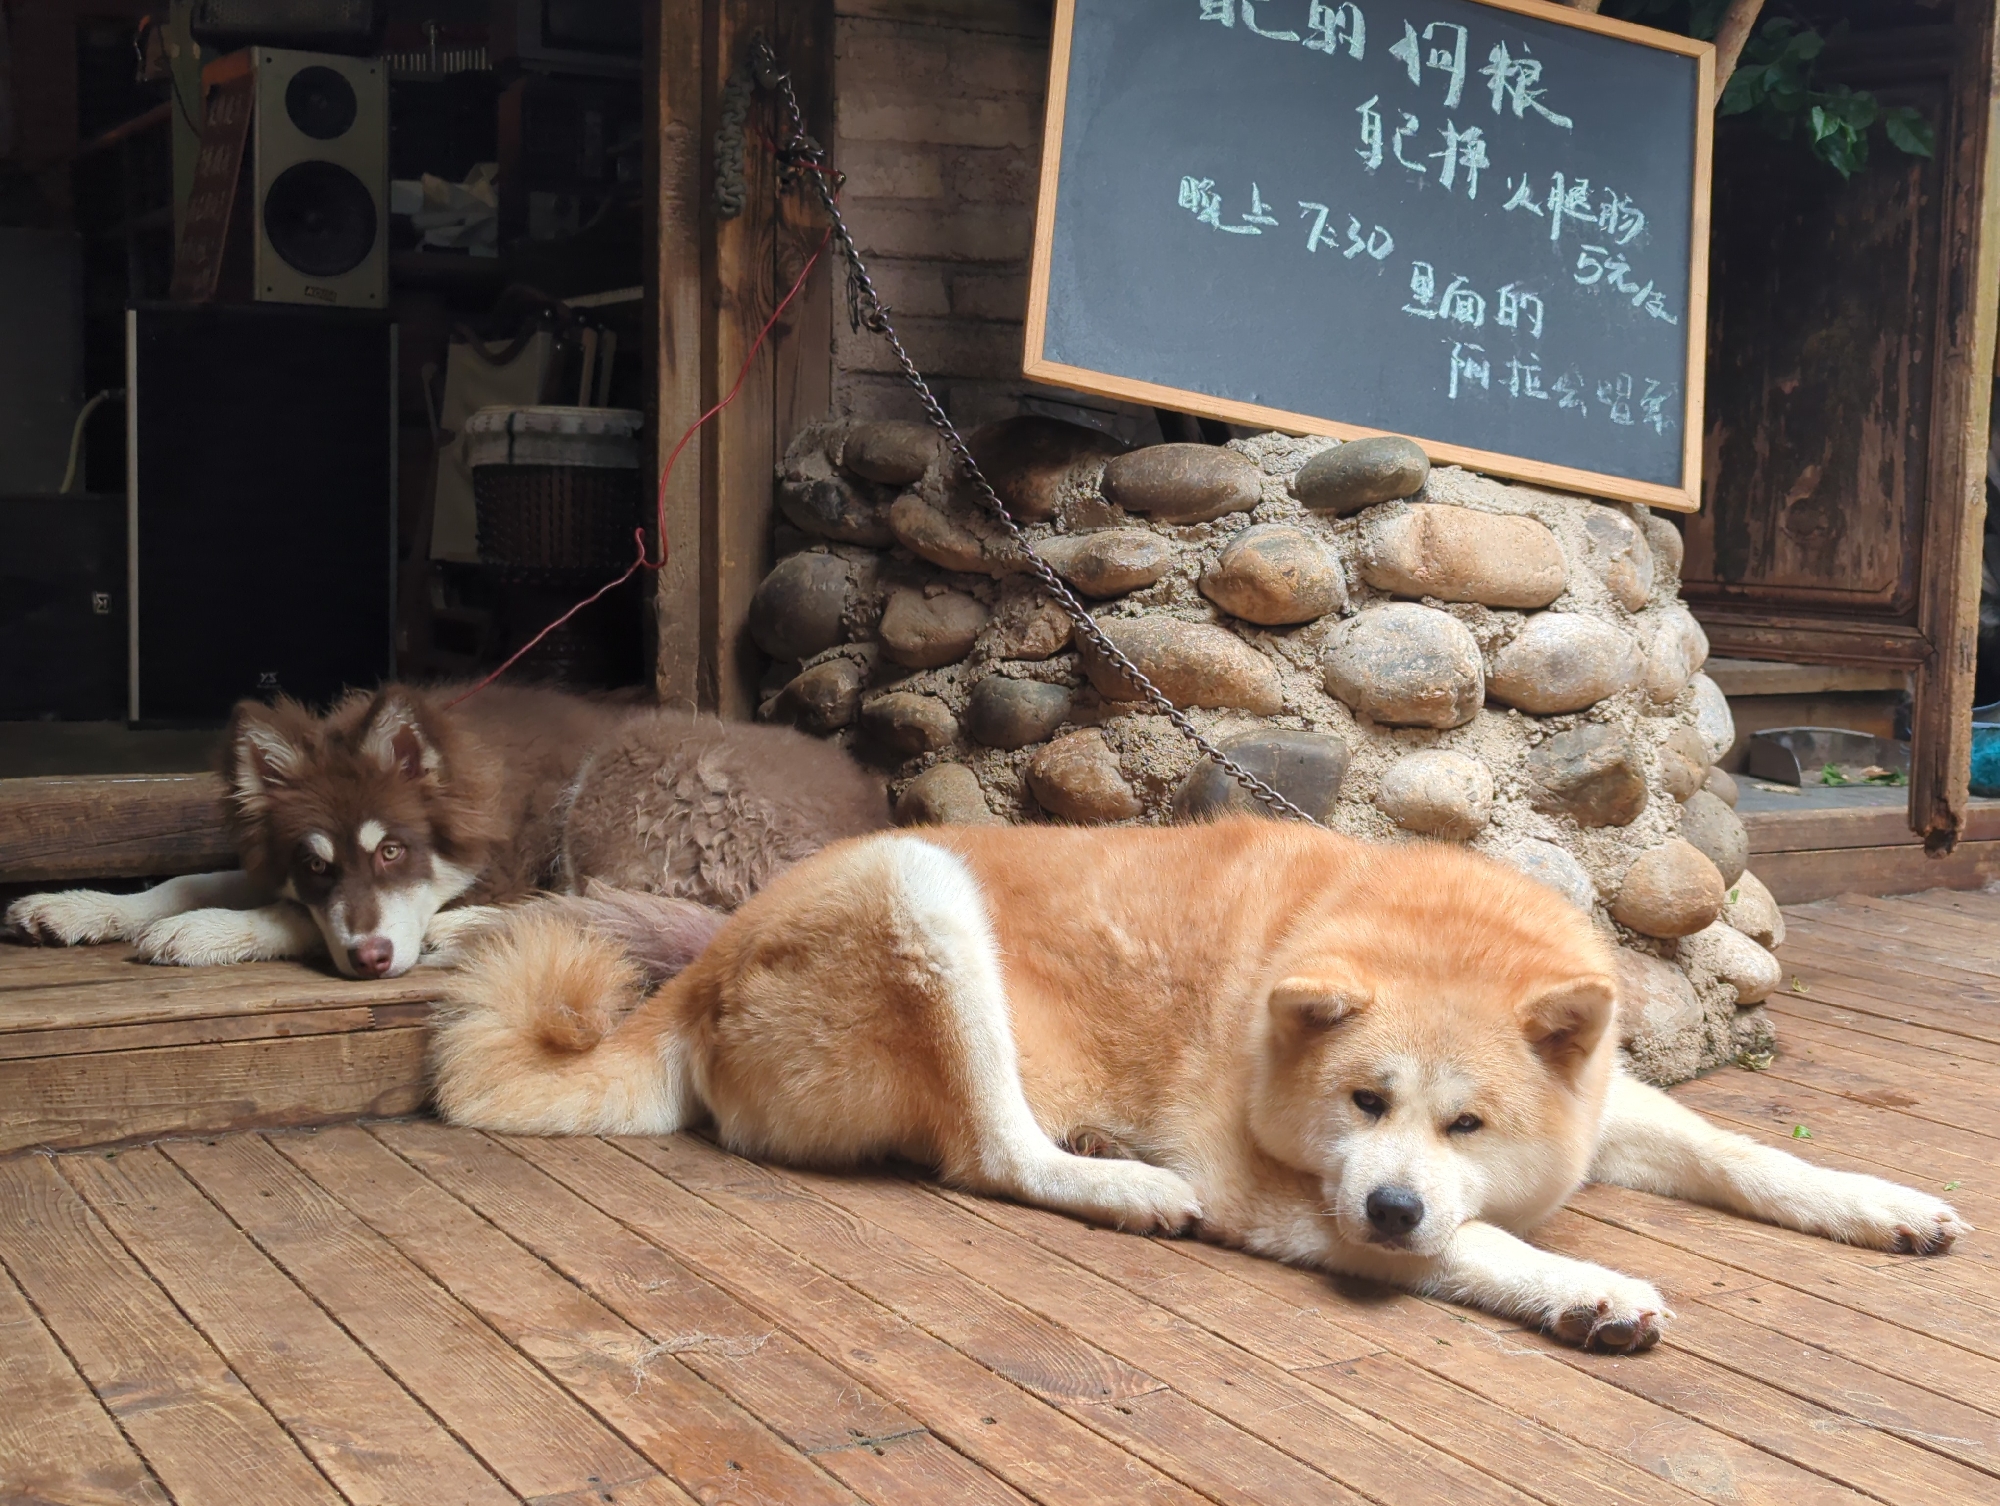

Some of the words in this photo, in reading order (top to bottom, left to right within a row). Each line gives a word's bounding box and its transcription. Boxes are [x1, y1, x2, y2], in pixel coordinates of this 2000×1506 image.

[1178, 176, 1279, 235] 晚上
[1298, 200, 1395, 260] 7:30
[1502, 171, 1645, 245] 火腿肠
[1401, 260, 1544, 339] 里面的
